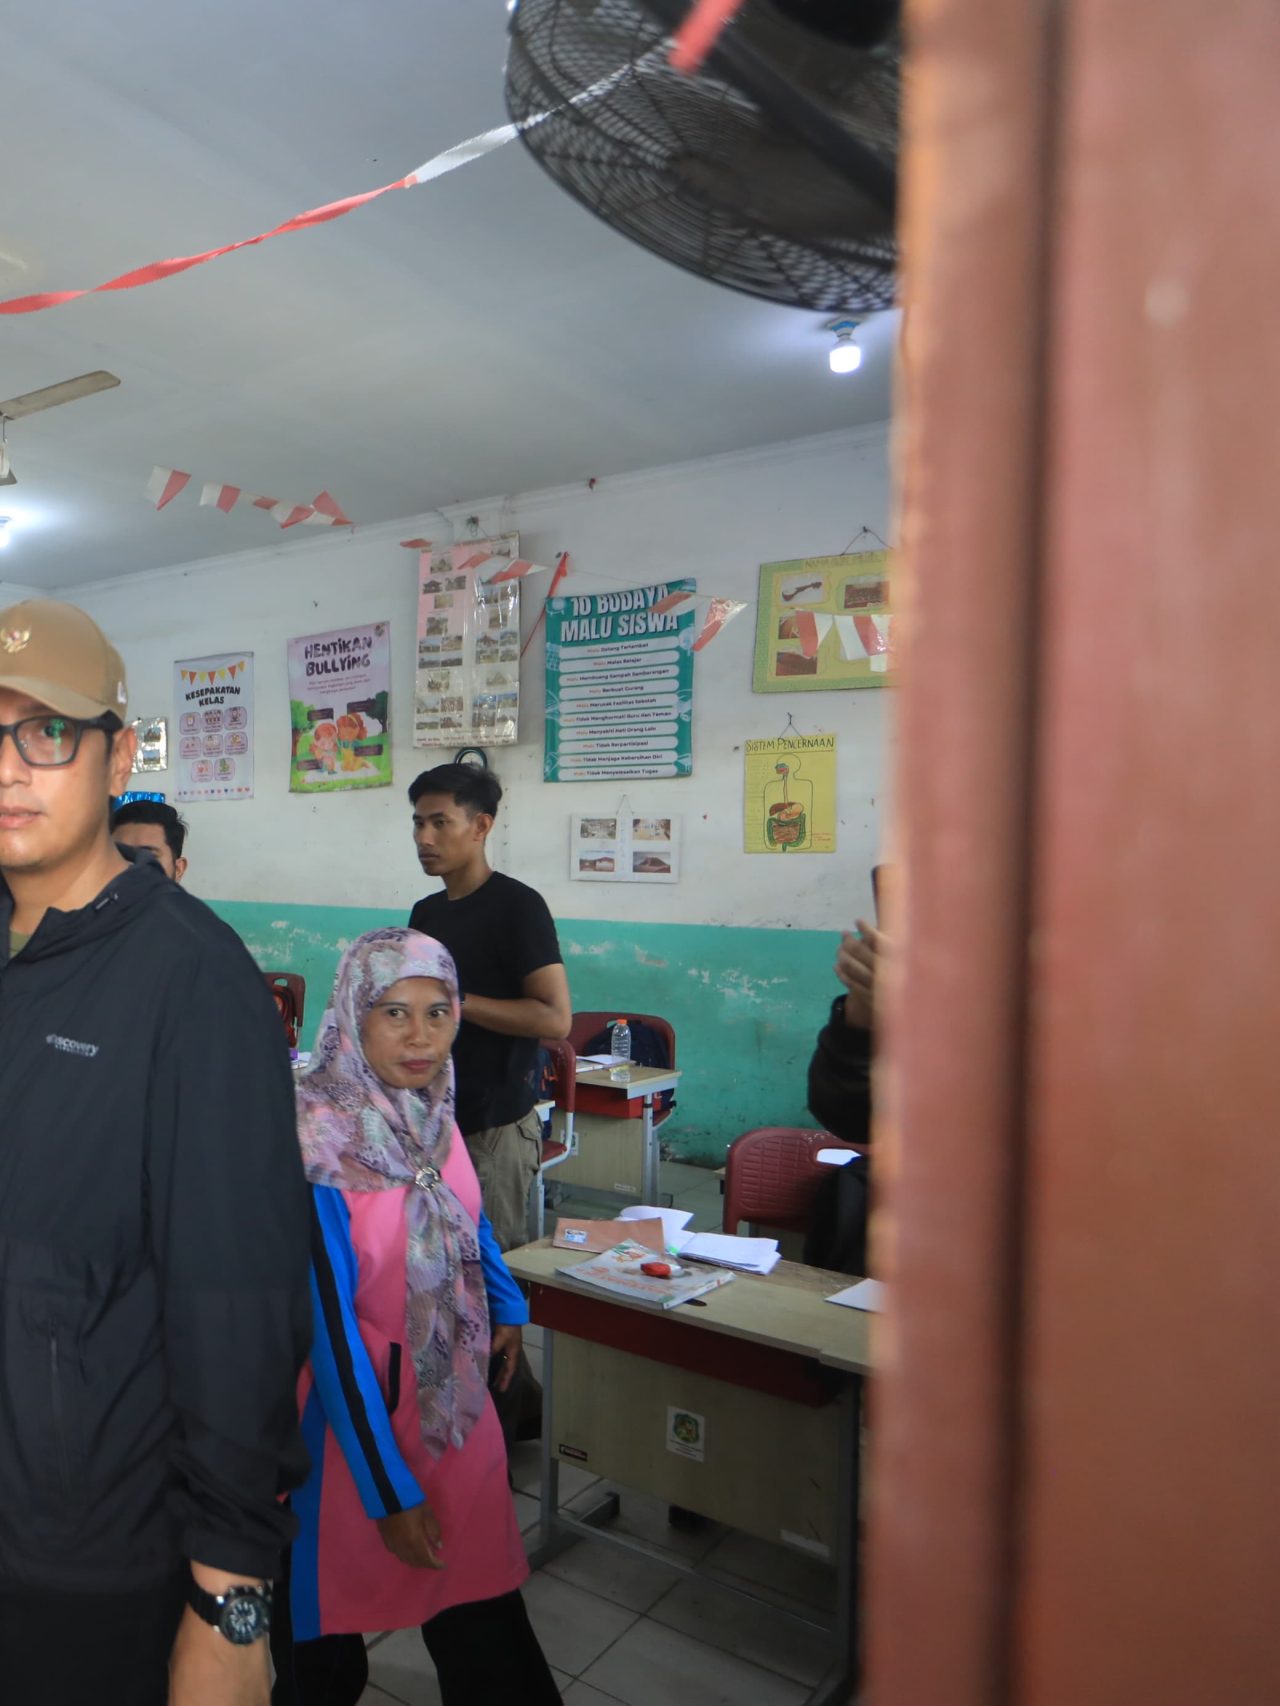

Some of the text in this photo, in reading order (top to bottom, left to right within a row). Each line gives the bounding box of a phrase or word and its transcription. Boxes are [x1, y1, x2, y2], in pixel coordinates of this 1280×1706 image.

[571, 584, 669, 617] 10 BUDAYA
[561, 612, 678, 643] MALU SISWA
[304, 636, 373, 659] HENTIKAN
[306, 654, 371, 677] BULLYING
[185, 686, 241, 701] KESEPAKATAN
[199, 696, 225, 707] KELAS
